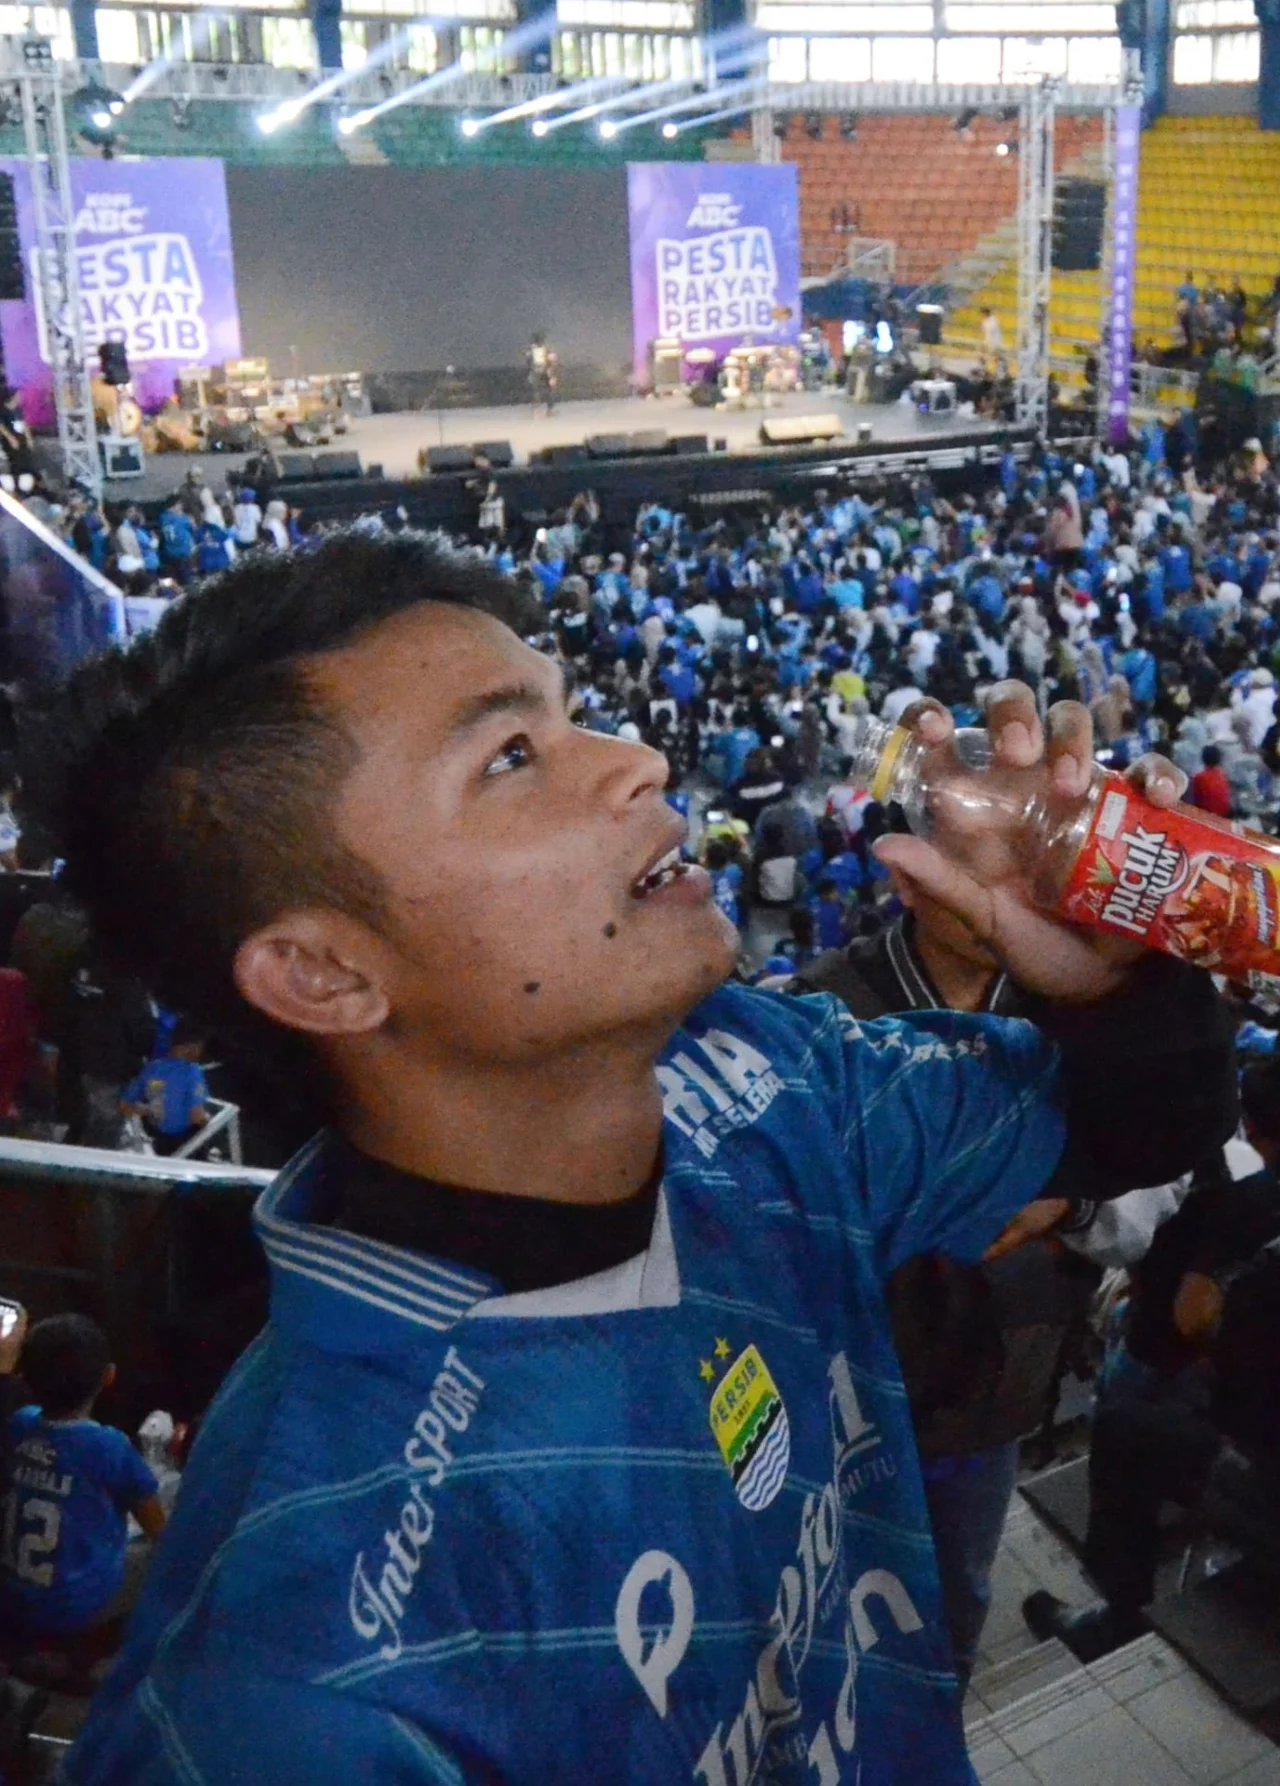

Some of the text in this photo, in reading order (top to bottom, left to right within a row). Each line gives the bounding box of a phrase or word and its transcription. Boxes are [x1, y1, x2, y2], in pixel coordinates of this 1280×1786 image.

[76, 240, 194, 290] ESTA
[662, 234, 769, 276] PESTA
[665, 276, 770, 306] RAKYAT
[666, 298, 773, 333] PERSIB
[1101, 824, 1166, 935] pucuk
[1135, 846, 1182, 923] HARUM
[711, 1358, 758, 1428] PERSIB
